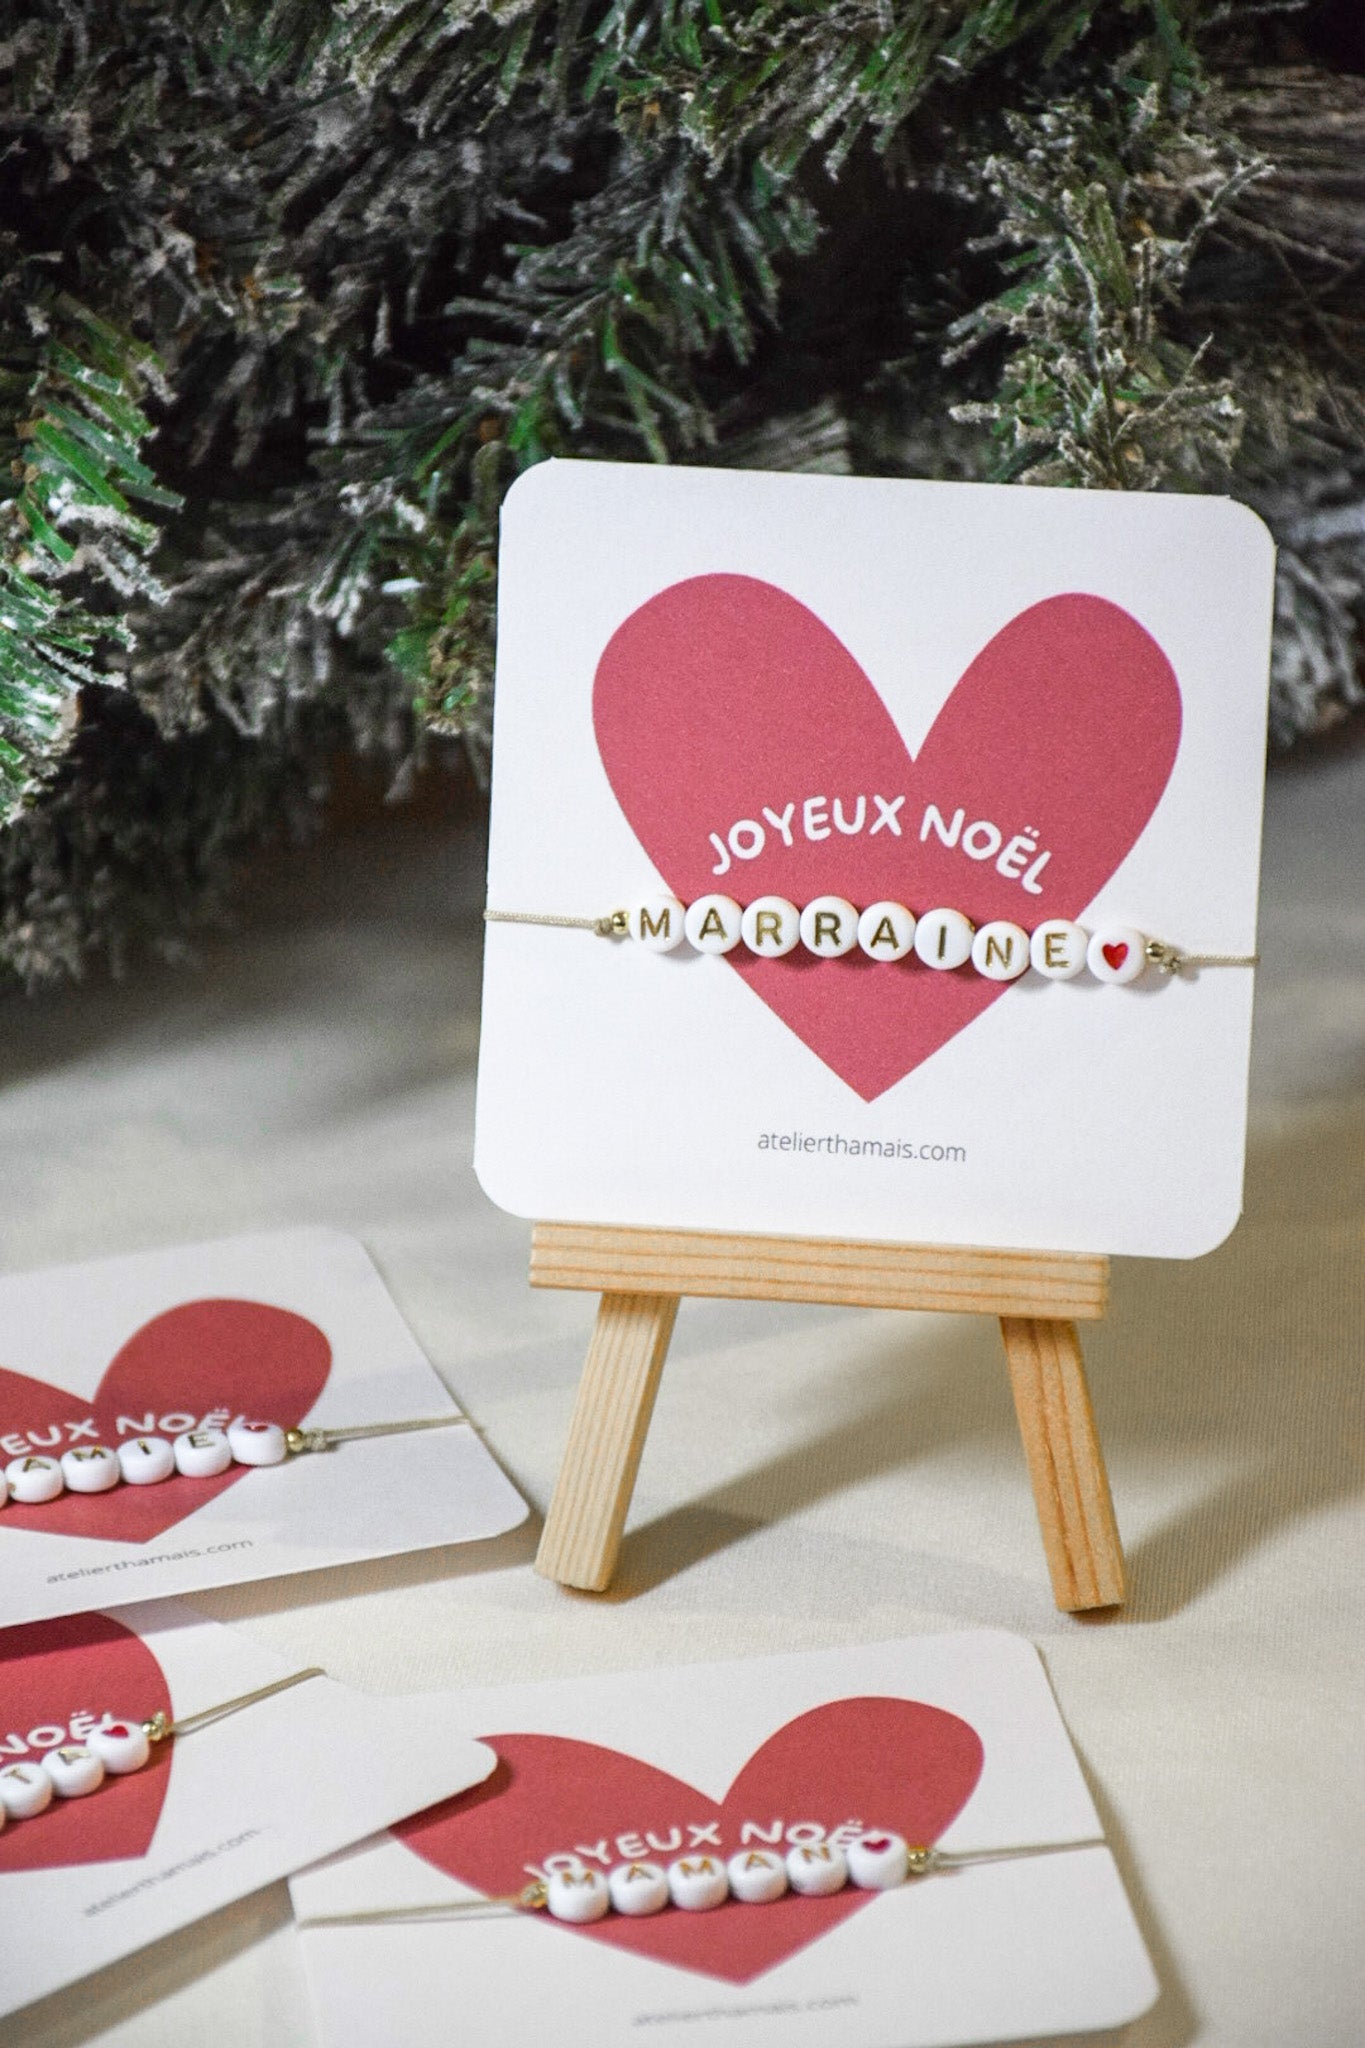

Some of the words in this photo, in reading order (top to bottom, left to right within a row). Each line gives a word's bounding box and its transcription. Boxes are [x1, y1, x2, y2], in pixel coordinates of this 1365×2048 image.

[709, 795, 906, 875] JOYEUX
[920, 804, 1052, 894] NOËL
[638, 906, 1070, 969] MARRAINE
[757, 1131, 967, 1163] atelierthamais.com
[46, 1538, 254, 1584] atelierthamais.com
[741, 1819, 864, 1848] NOË
